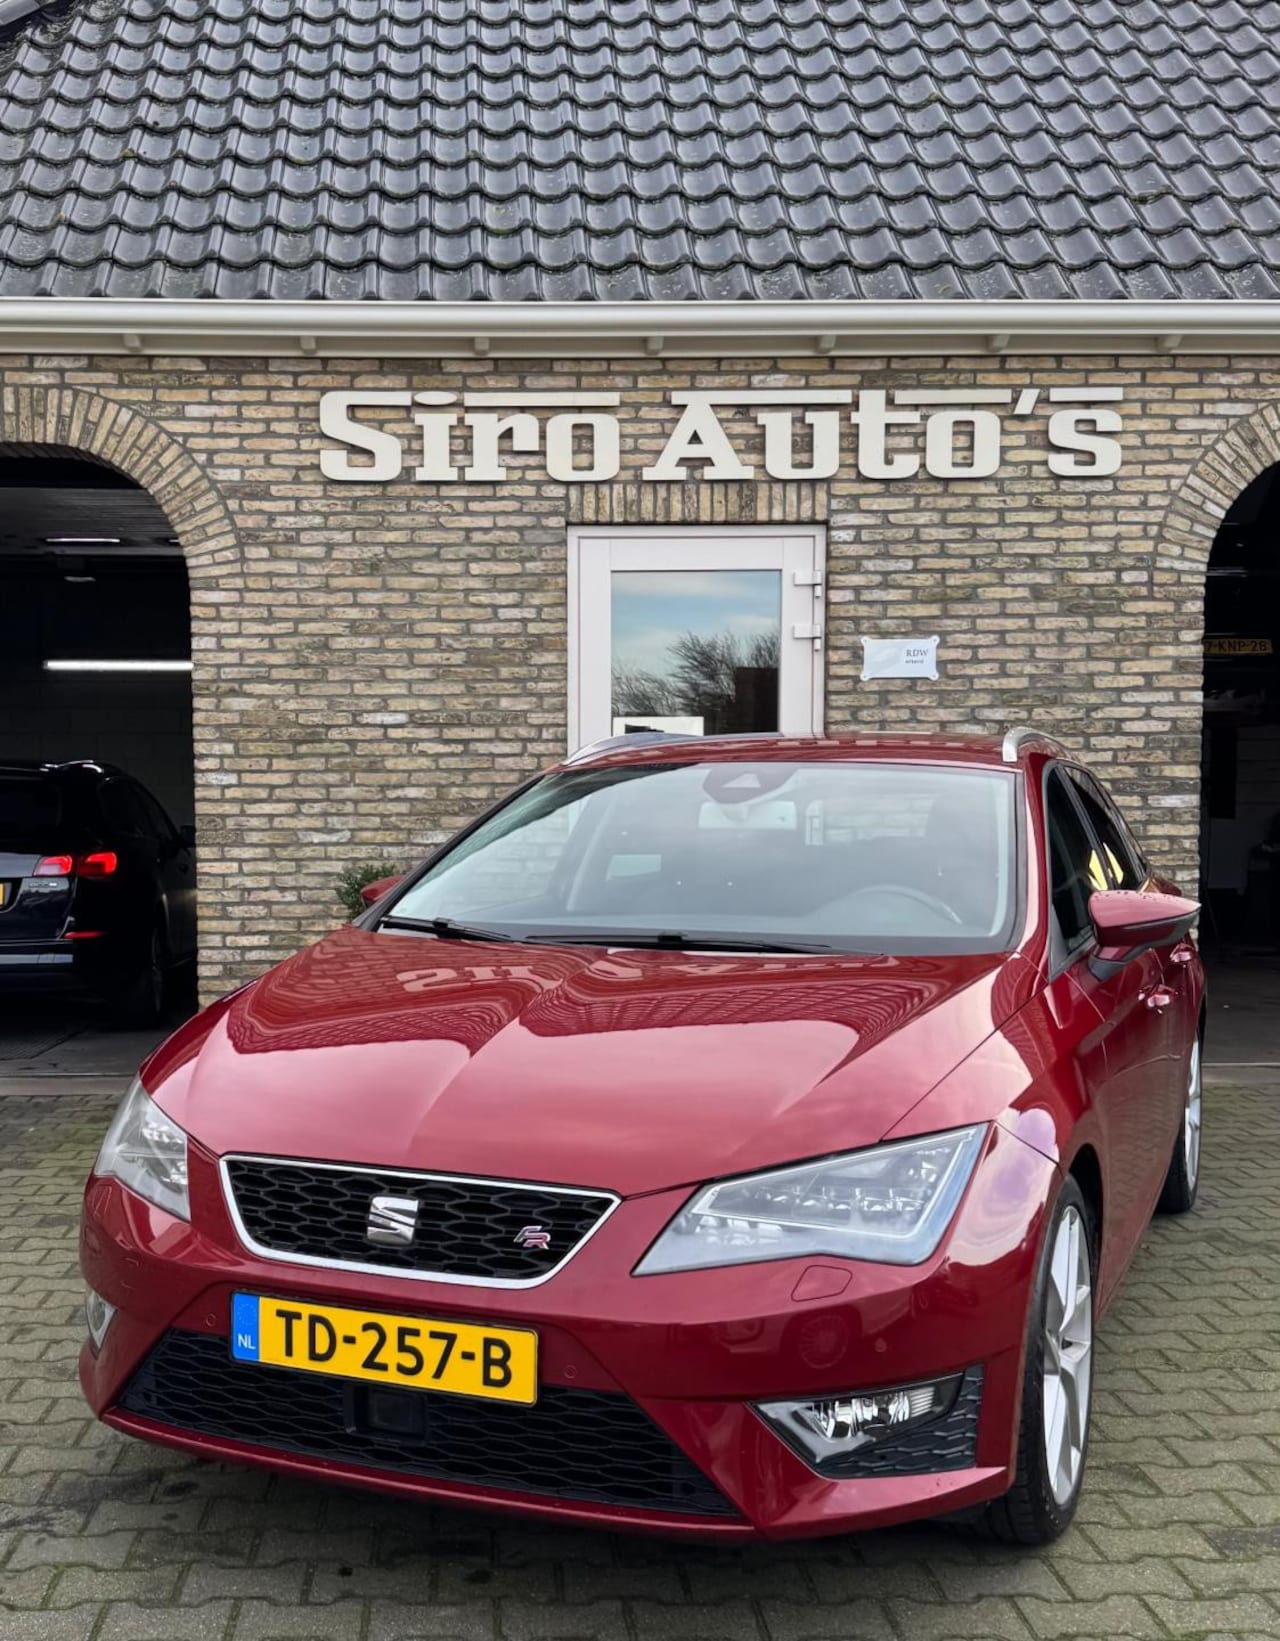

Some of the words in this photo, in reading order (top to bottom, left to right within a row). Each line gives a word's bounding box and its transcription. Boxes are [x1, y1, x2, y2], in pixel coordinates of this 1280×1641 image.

[319, 390, 620, 482] Siro
[642, 387, 1123, 480] Auto's
[906, 649, 929, 657] RDW
[237, 1333, 257, 1350] NL
[275, 1309, 512, 1388] TD-257-B
